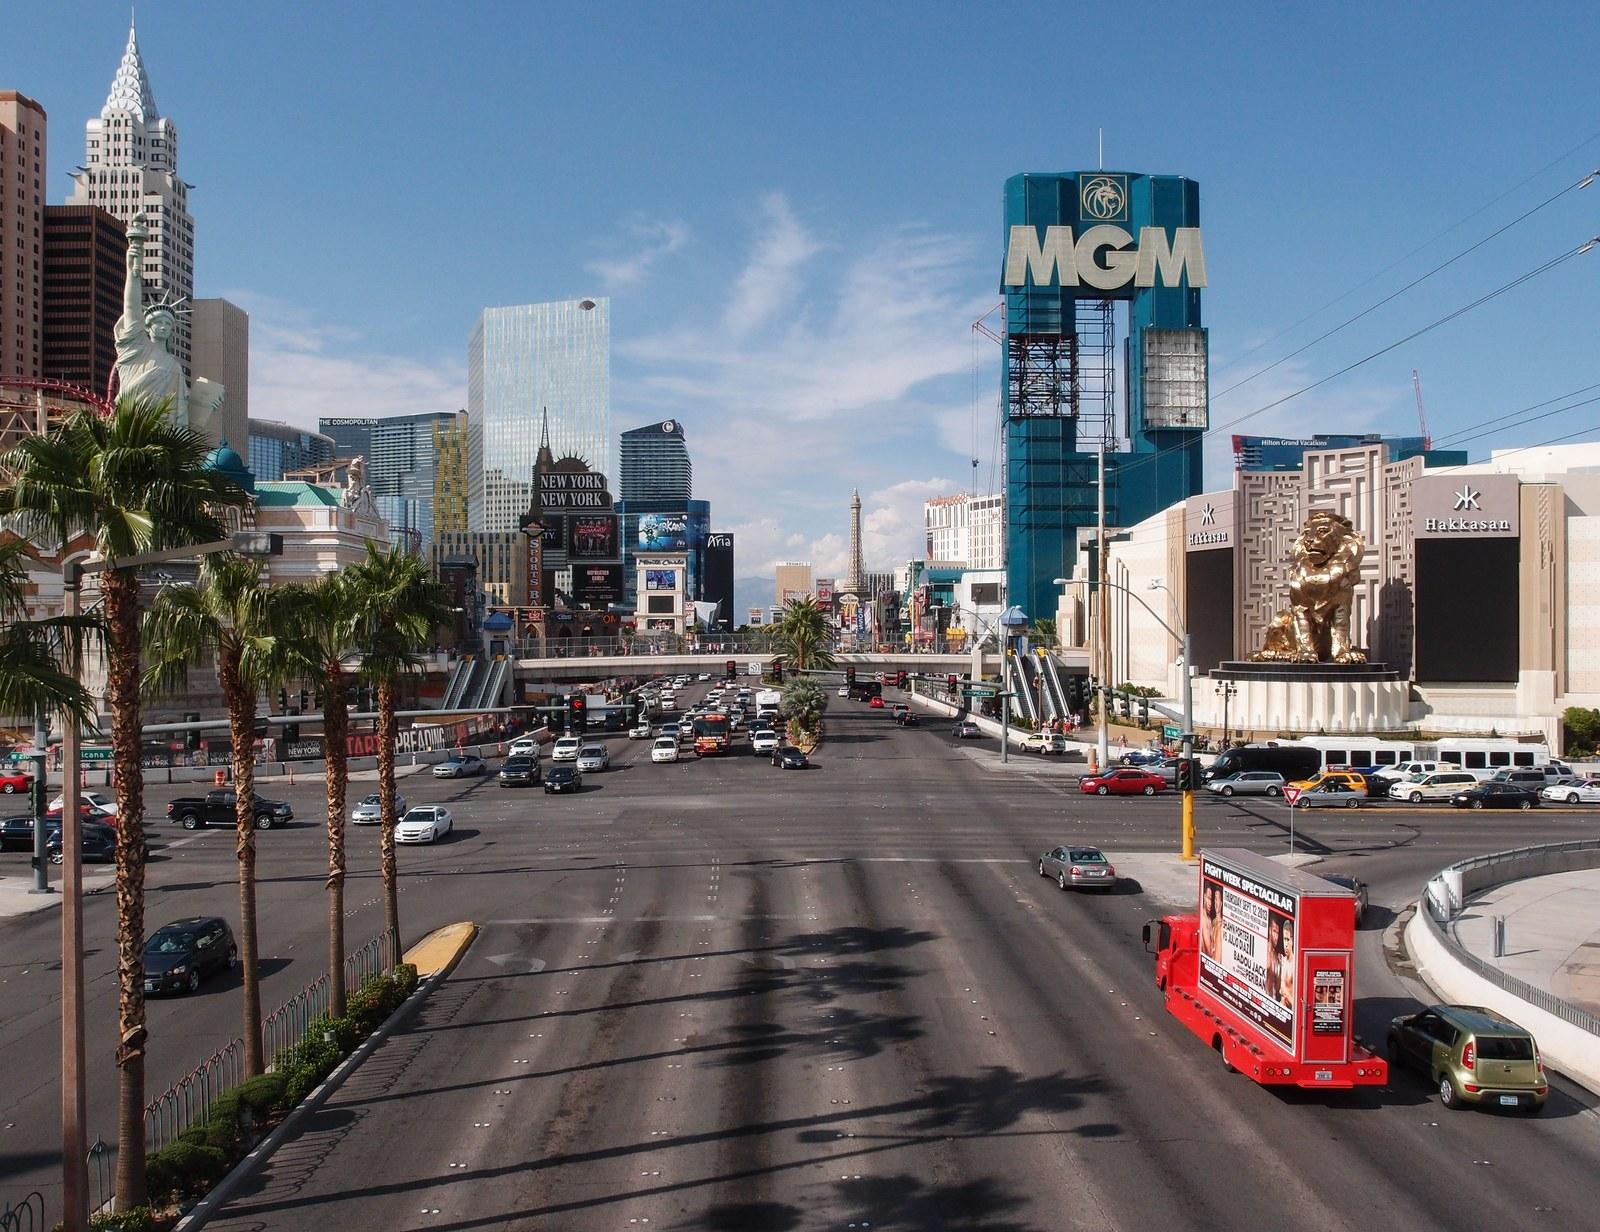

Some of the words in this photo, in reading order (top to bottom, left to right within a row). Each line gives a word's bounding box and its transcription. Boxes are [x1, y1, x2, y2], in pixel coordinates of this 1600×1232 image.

[1005, 225, 1208, 290] MGM
[540, 474, 567, 489] NEW
[570, 474, 602, 489] YORK
[540, 492, 567, 506] NEW
[570, 492, 602, 506] YORK
[1425, 517, 1511, 533] Hakkasan
[707, 535, 731, 548] Aria
[1189, 532, 1228, 546] Hakkasan
[530, 539, 539, 586] SPORTS
[1204, 862, 1222, 879] FIGHT
[1222, 870, 1241, 888] WEEK
[1241, 878, 1293, 913] SPECTACULAR
[1252, 961, 1266, 978] JACK
